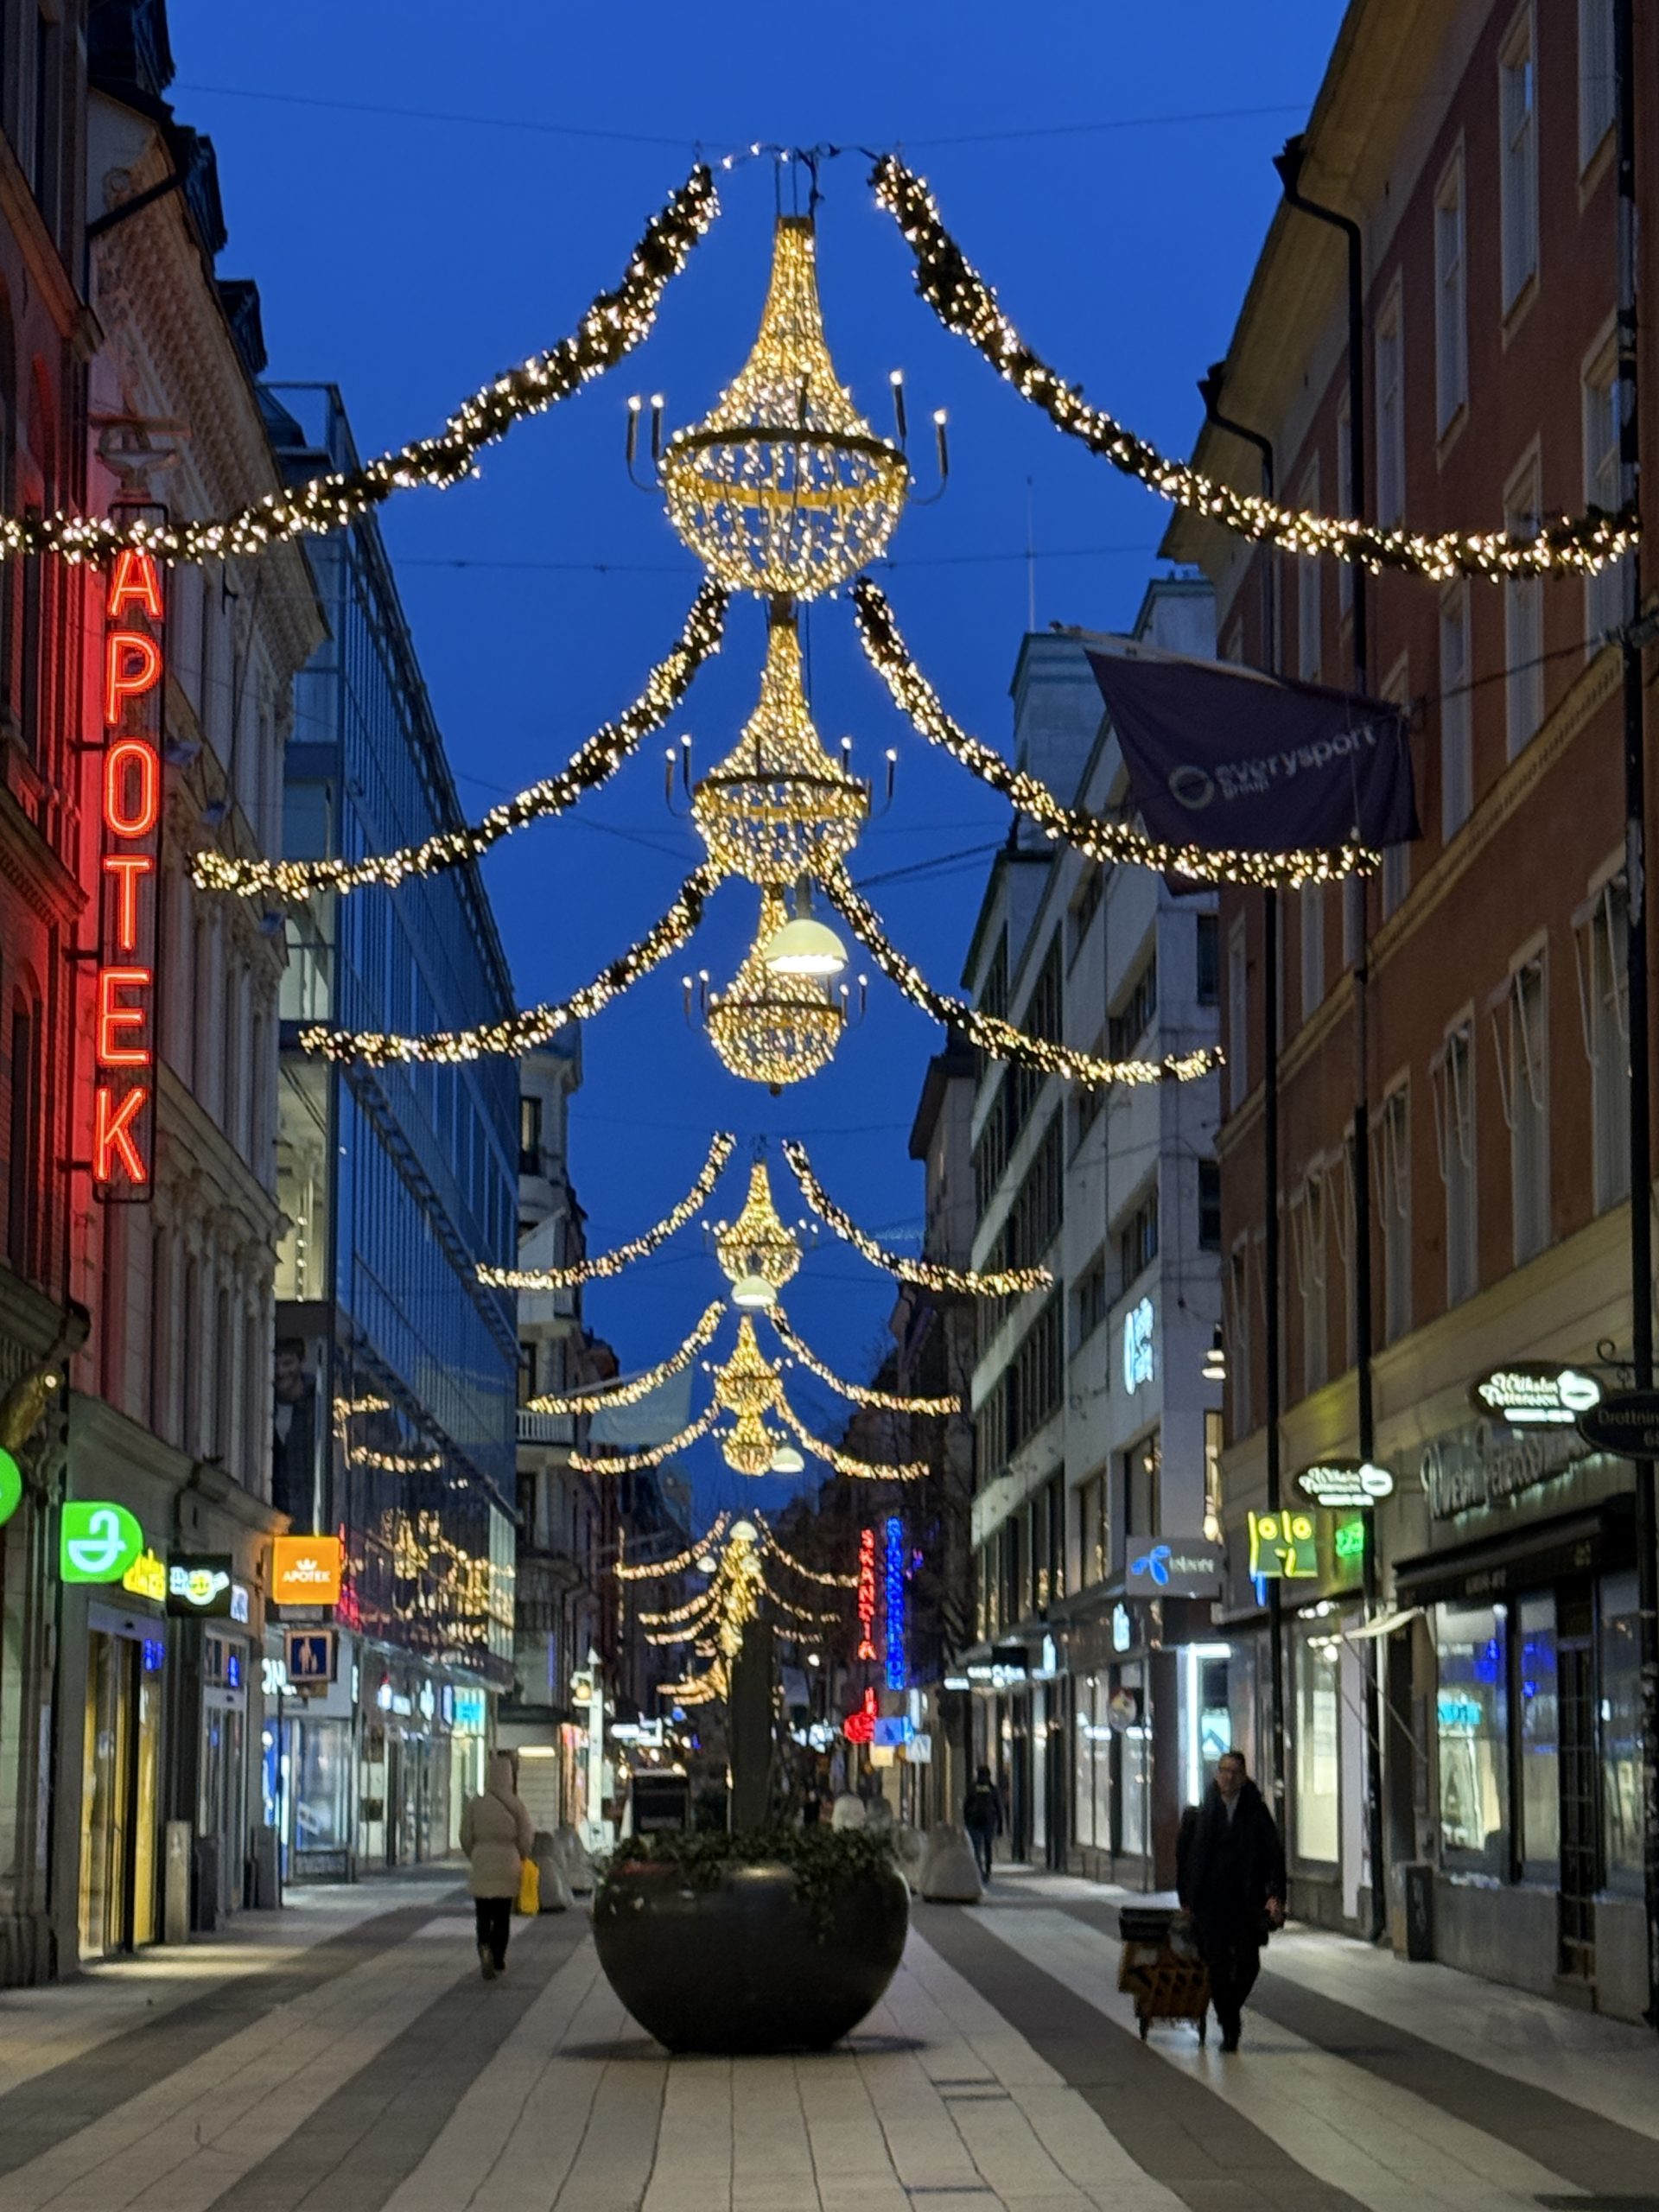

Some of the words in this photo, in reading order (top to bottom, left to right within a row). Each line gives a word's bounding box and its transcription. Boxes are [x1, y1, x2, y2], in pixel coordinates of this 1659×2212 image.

[1215, 725, 1376, 781] everysport
[92, 547, 163, 1185] APOTEK
[282, 1570, 332, 1583] APOTEK
